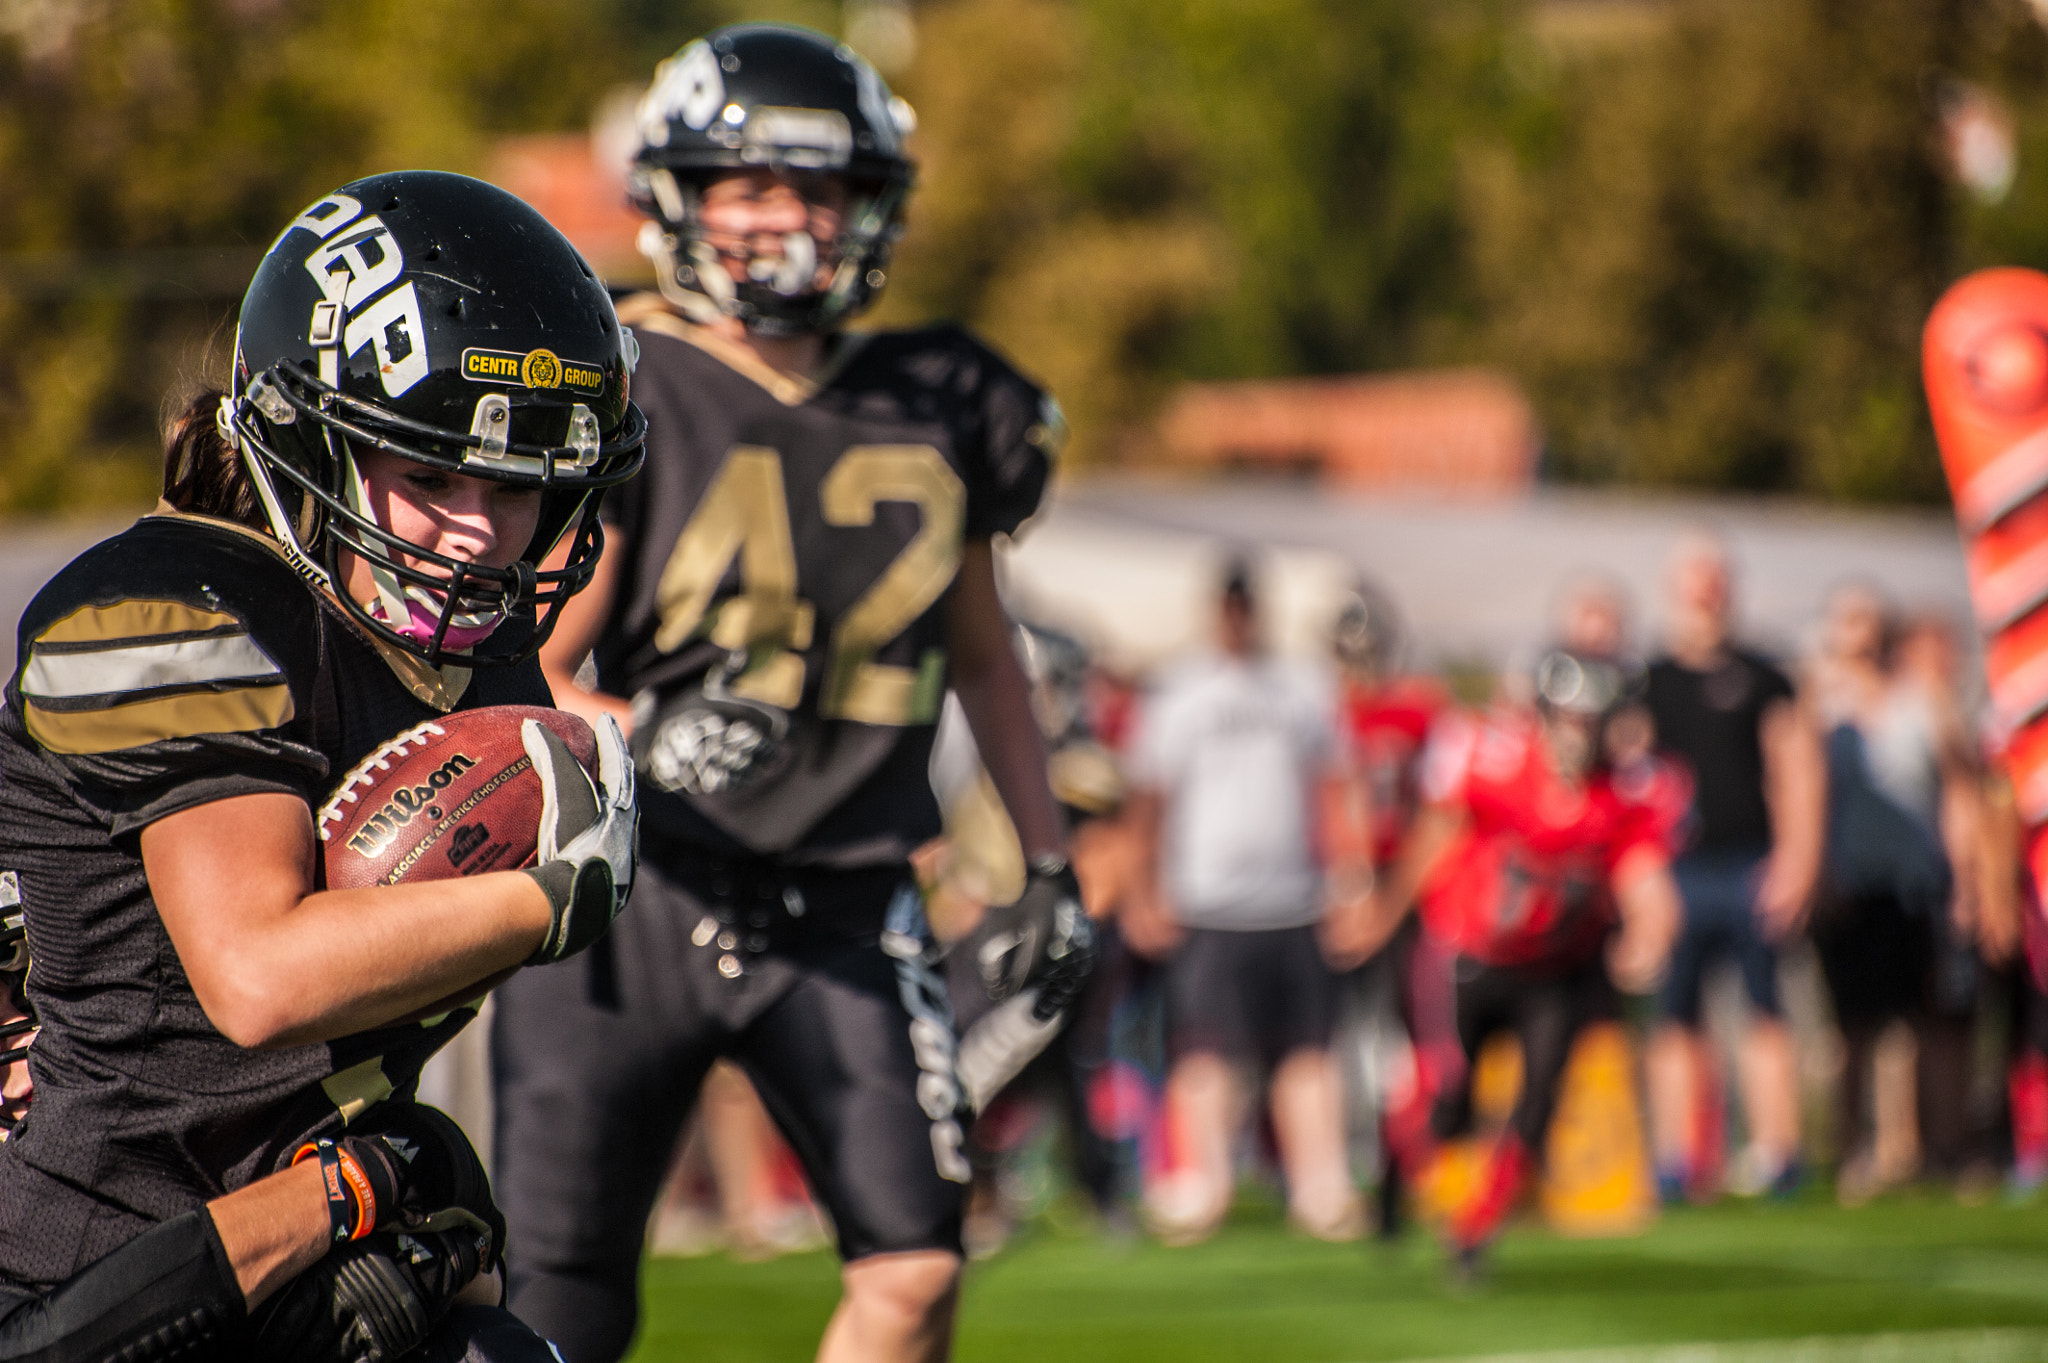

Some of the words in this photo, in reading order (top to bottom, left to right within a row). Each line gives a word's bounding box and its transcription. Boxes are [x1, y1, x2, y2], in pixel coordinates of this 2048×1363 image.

[468, 355, 518, 377] CENTR
[564, 367, 602, 389] GROUP
[654, 443, 968, 727] 42
[346, 752, 480, 858] Wilson
[387, 833, 437, 886] ASOCIACE
[323, 1162, 346, 1202] LIONS
